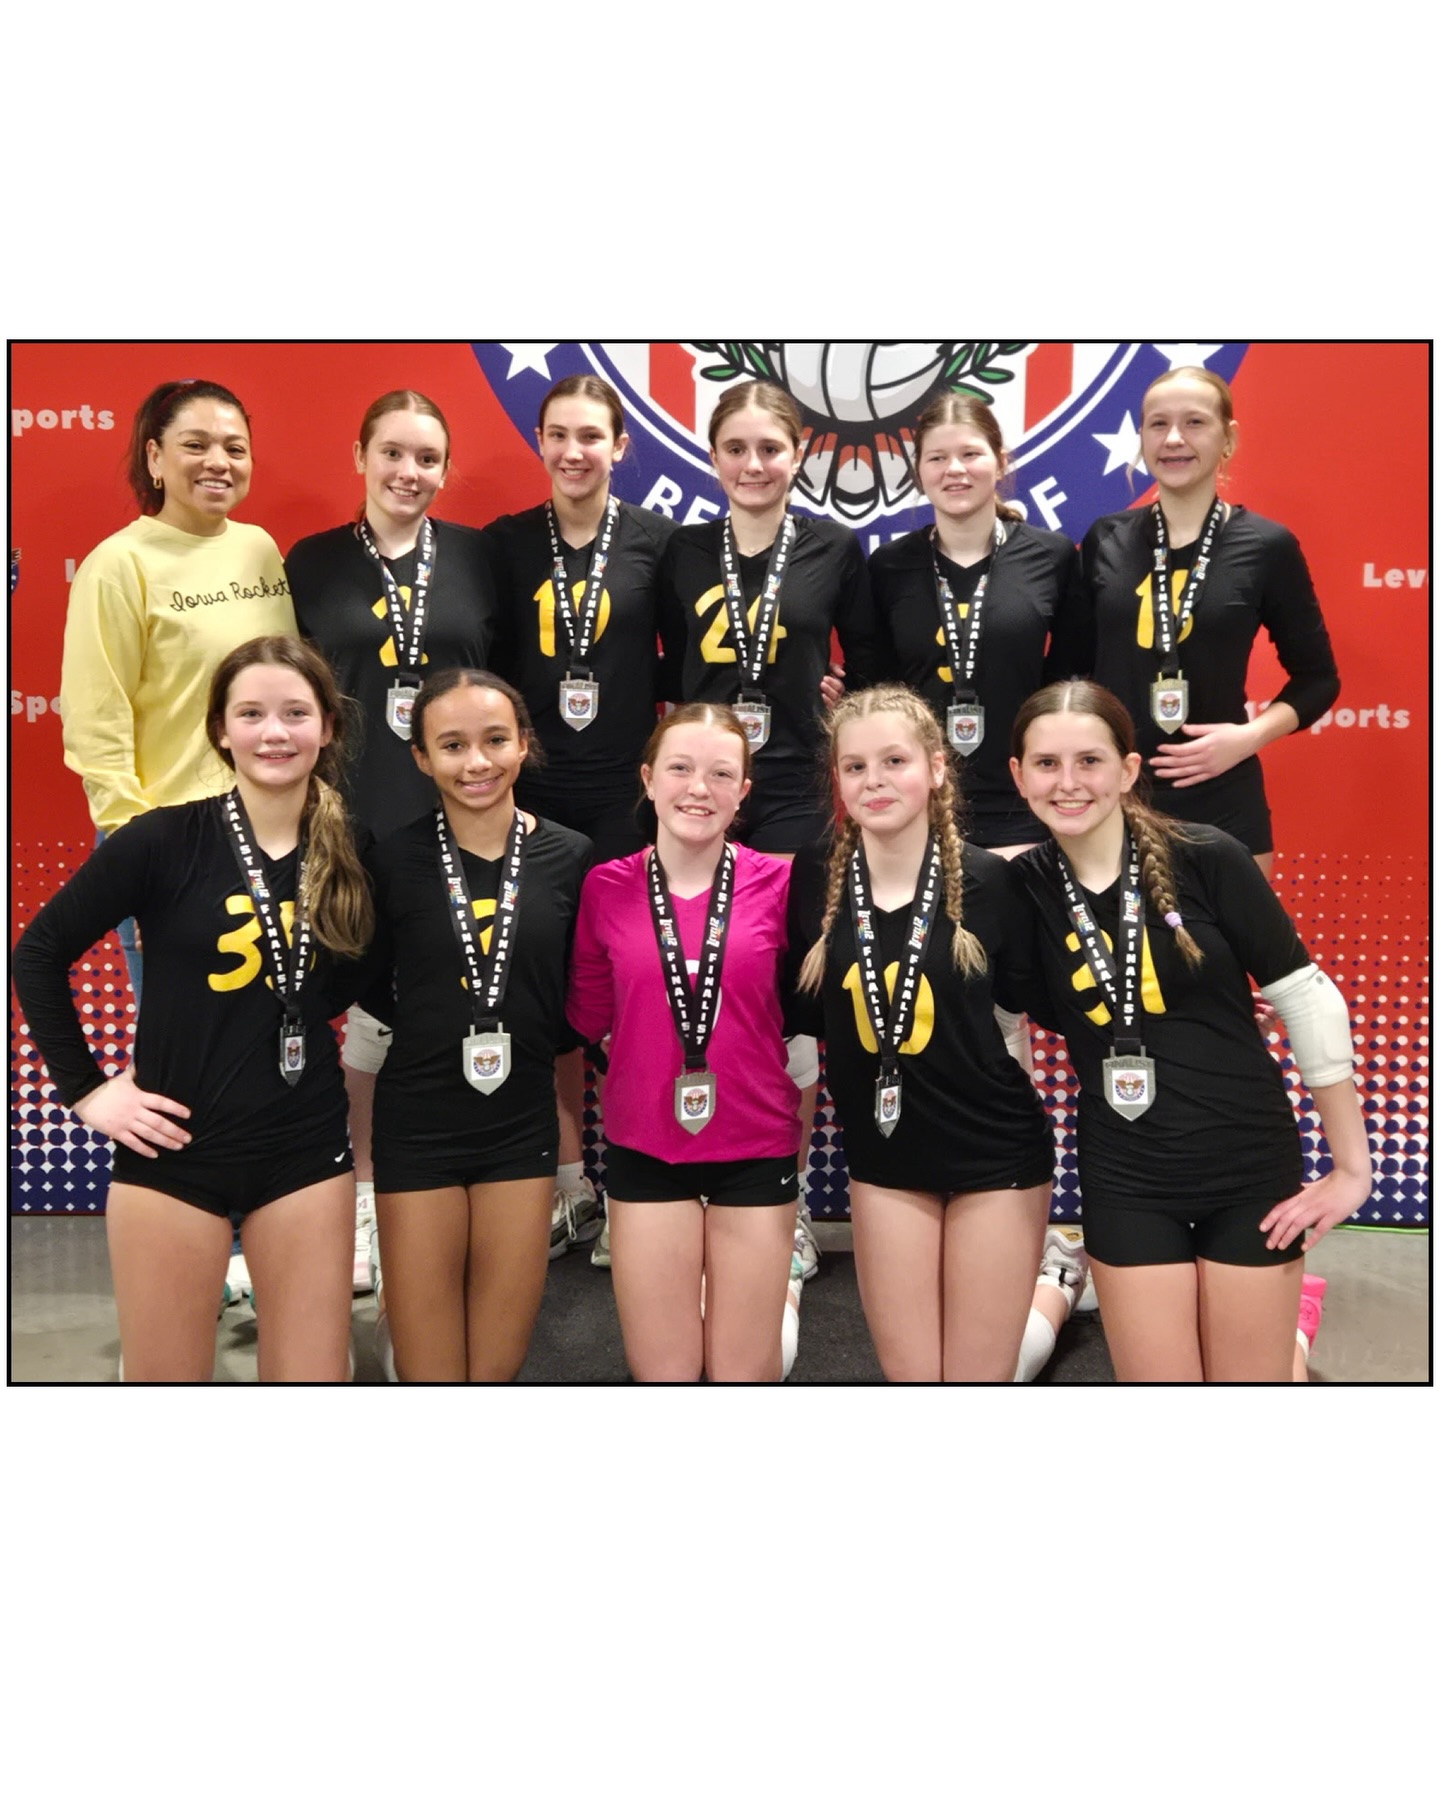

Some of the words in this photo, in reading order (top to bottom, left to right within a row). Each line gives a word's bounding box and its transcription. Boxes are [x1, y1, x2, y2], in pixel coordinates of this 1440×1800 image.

[11, 404, 115, 437] ports
[1202, 502, 1223, 554] NALIST
[169, 590, 230, 612] Iowa
[229, 576, 292, 600] Rocket
[1158, 574, 1171, 652] FINALIST
[1362, 562, 1429, 589] Lev
[409, 589, 427, 666] FINALIST
[579, 581, 600, 657] FINALIST
[752, 603, 773, 681] FINALIST
[965, 601, 983, 679] FINALIST
[1310, 703, 1411, 735] ports
[510, 812, 524, 877] NALIST
[717, 848, 732, 914] NALIST
[922, 842, 941, 913] NALIST
[226, 800, 253, 866] NALIST
[259, 904, 287, 995] FINALIST
[436, 811, 454, 874] NALIST
[456, 909, 483, 996] FINALIS
[487, 915, 513, 1008] FINALIST
[852, 849, 865, 907] ALIST
[862, 945, 886, 1040] FINALIST
[1123, 928, 1137, 1027] FINALIST
[666, 951, 691, 1039] FINALIS
[695, 953, 718, 1046] FINALIST
[892, 953, 919, 1046] FINALIST
